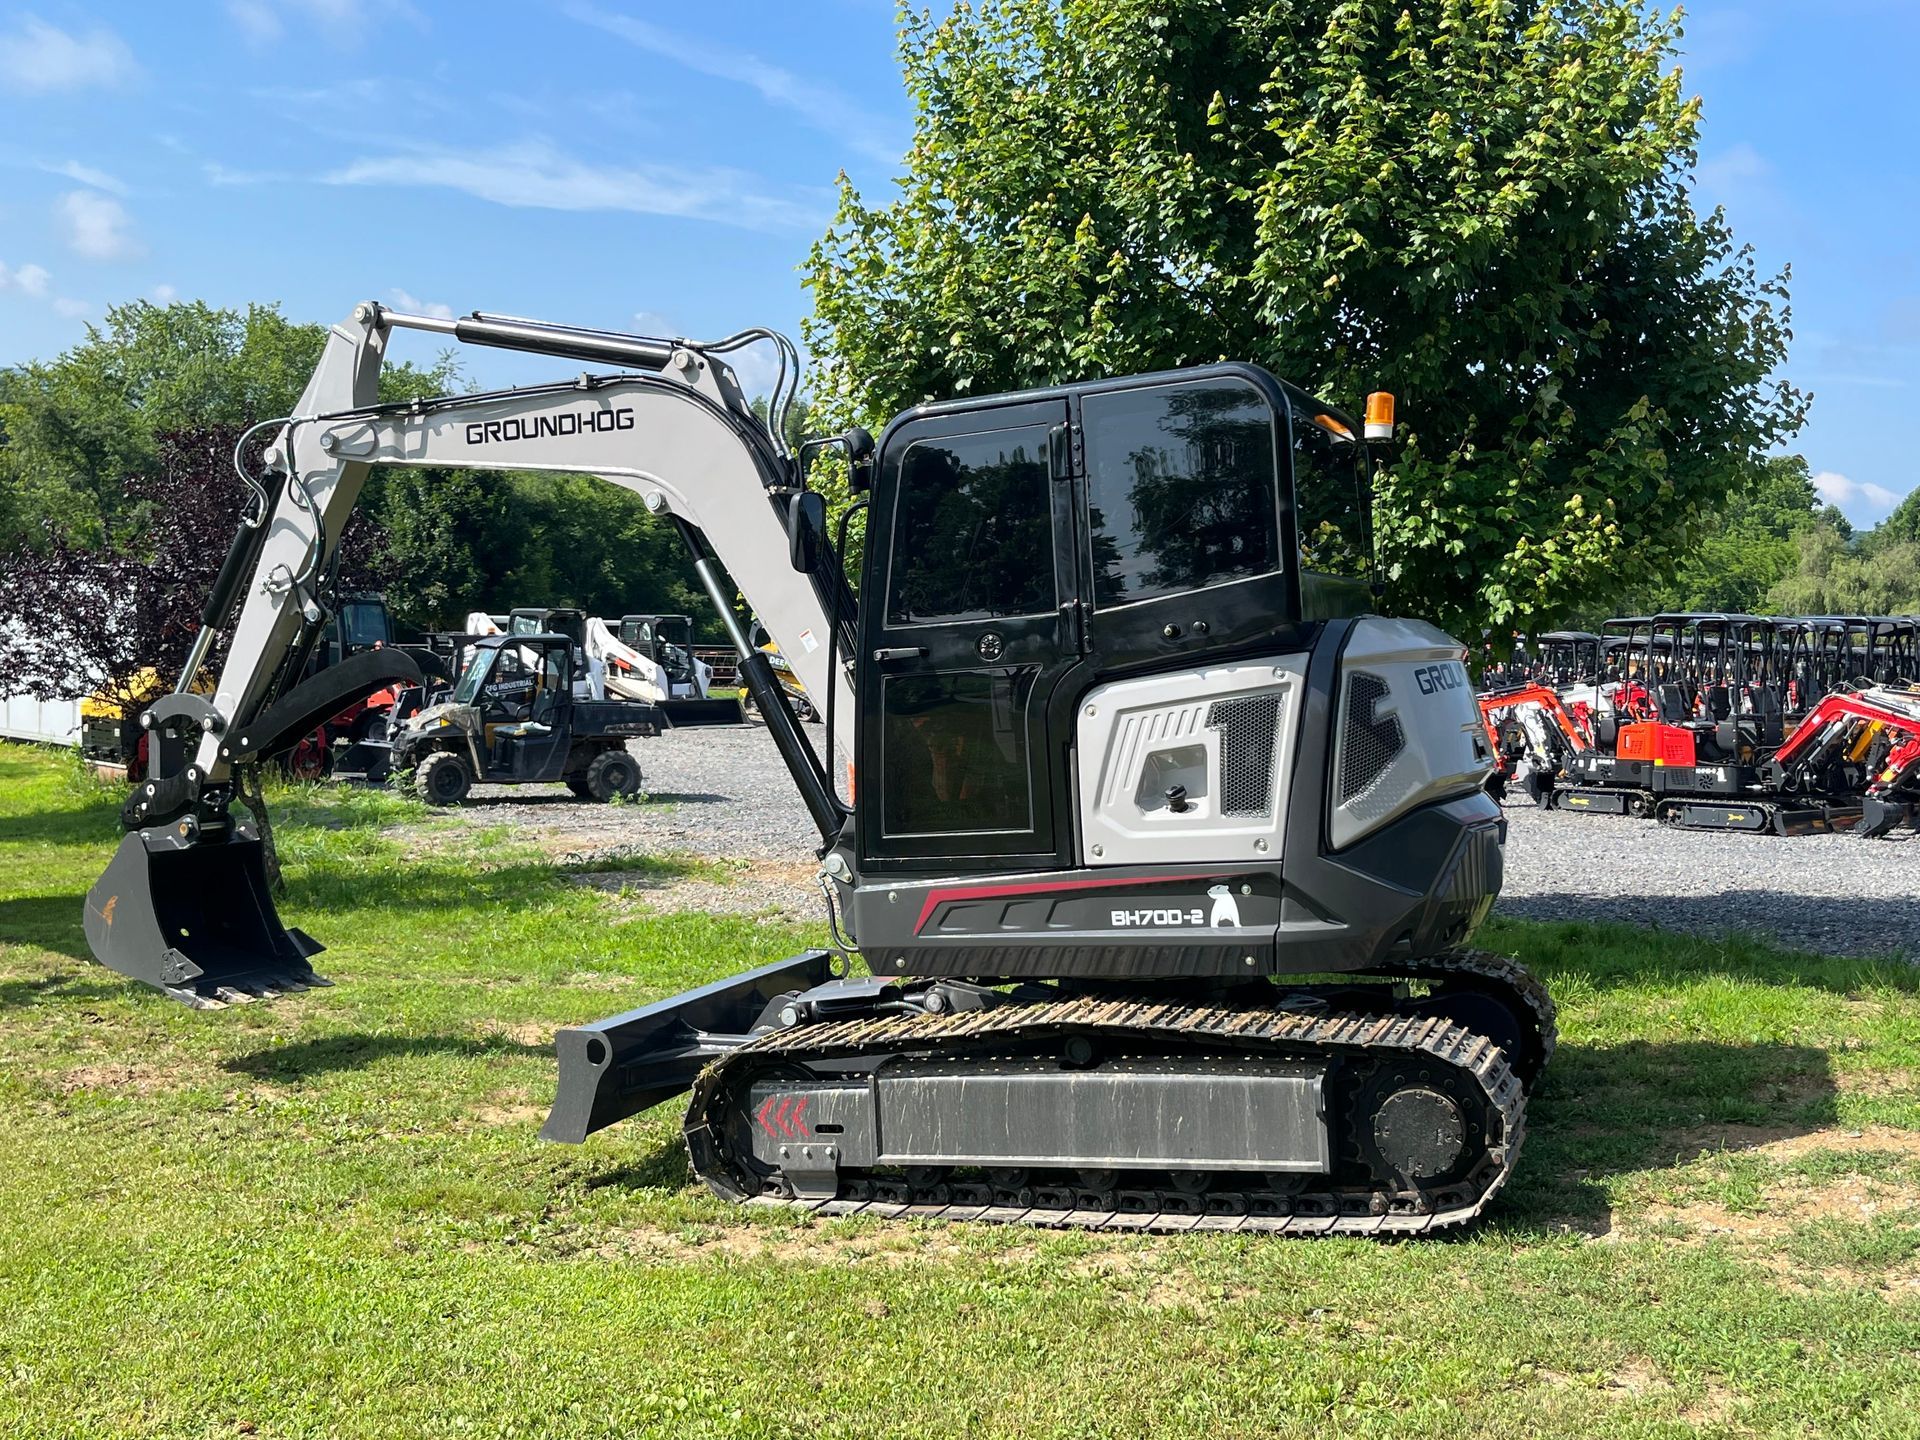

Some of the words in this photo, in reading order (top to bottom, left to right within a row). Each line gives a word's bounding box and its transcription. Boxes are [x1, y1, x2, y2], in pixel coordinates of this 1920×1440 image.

[466, 408, 635, 445] GROUNDHOG
[769, 656, 787, 667] DEE
[498, 679, 534, 690] INDUSTRIAL
